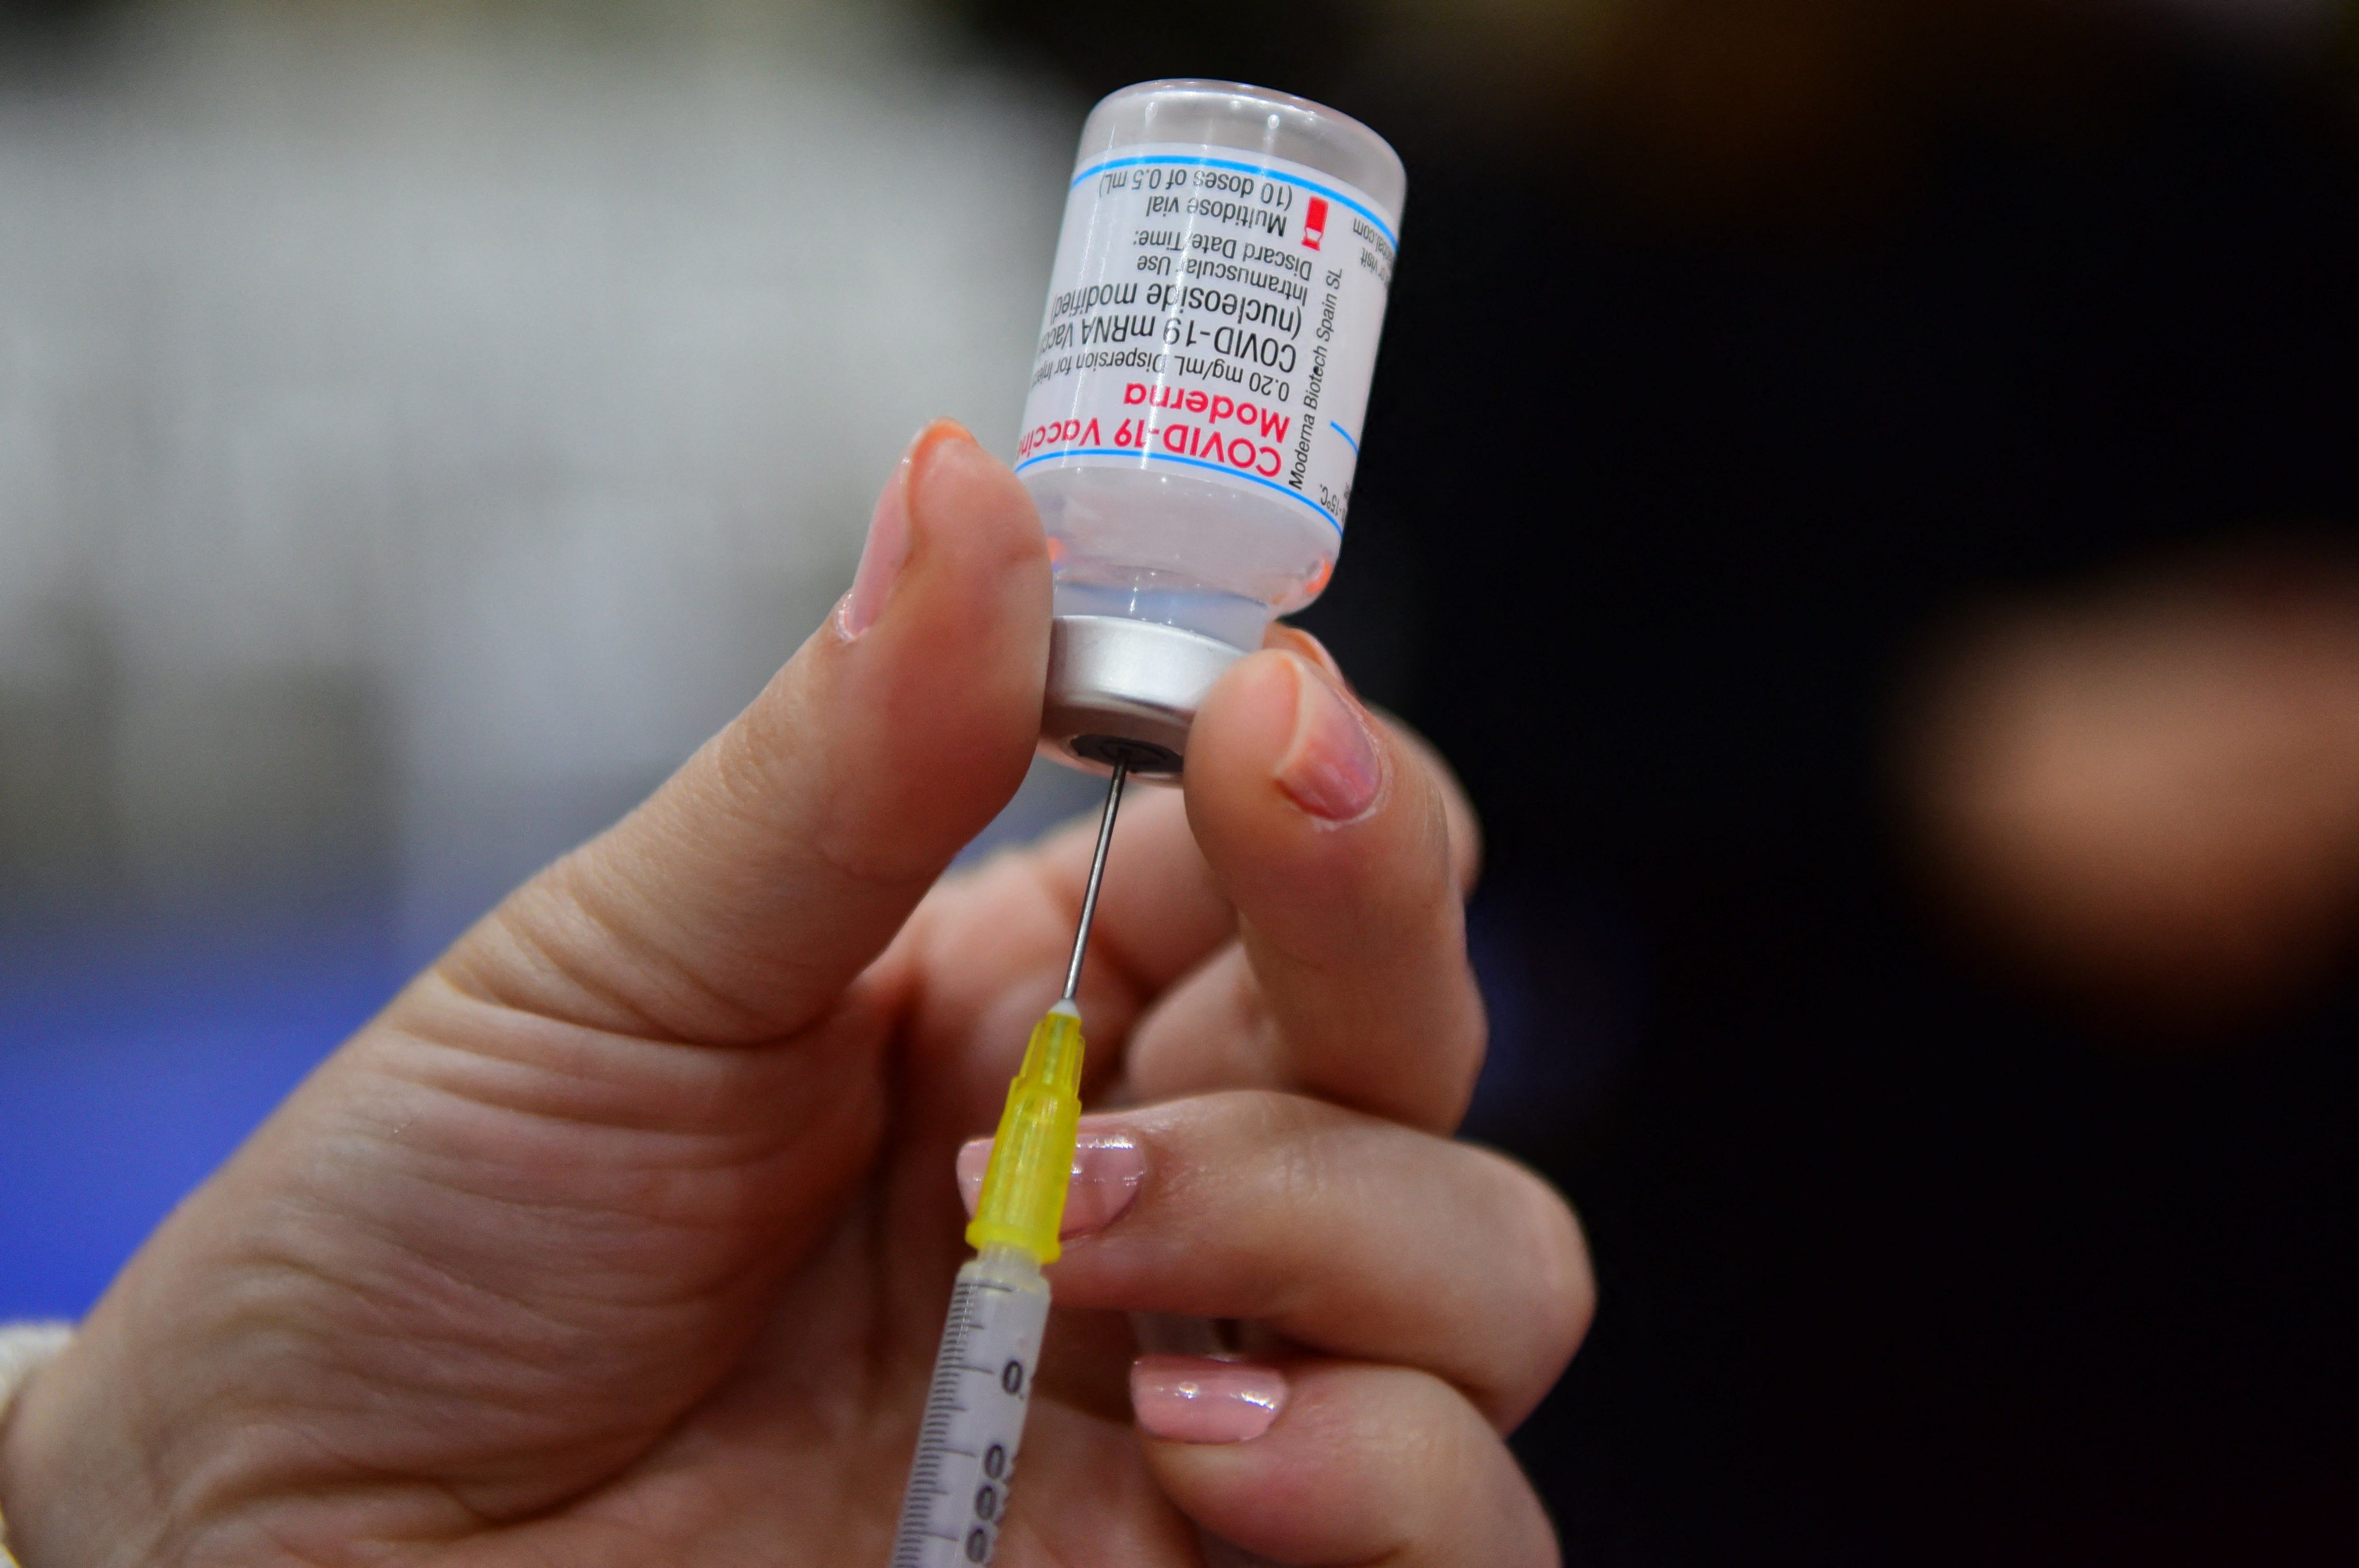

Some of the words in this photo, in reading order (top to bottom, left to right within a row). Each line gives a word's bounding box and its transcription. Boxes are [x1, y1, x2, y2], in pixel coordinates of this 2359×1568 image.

[1099, 169, 1128, 198] mL)
[1132, 168, 1162, 190] 0.5
[1166, 169, 1187, 190] of
[1193, 170, 1254, 198] doses
[1146, 196, 1179, 217] vial
[1261, 183, 1292, 212] (10
[1187, 198, 1287, 237] Multidose
[1137, 256, 1171, 276] Use
[1242, 242, 1312, 281] Discard
[1360, 247, 1378, 274] visit
[1326, 269, 1342, 290] SL
[1050, 283, 1138, 326] modified)
[1147, 283, 1302, 340] (nucleoside
[1316, 293, 1337, 342] Spain
[1081, 315, 1156, 345] mRNA
[1163, 317, 1296, 373] COVID-19
[1054, 356, 1072, 376] for
[1076, 347, 1167, 374] Dispersion
[1174, 356, 1244, 383] mg/mL
[1249, 372, 1289, 402] 0.20
[1303, 346, 1328, 410] Biotech
[1124, 383, 1290, 444] Moderna
[1114, 418, 1282, 477] COVID-19
[1289, 414, 1315, 490] Moderna
